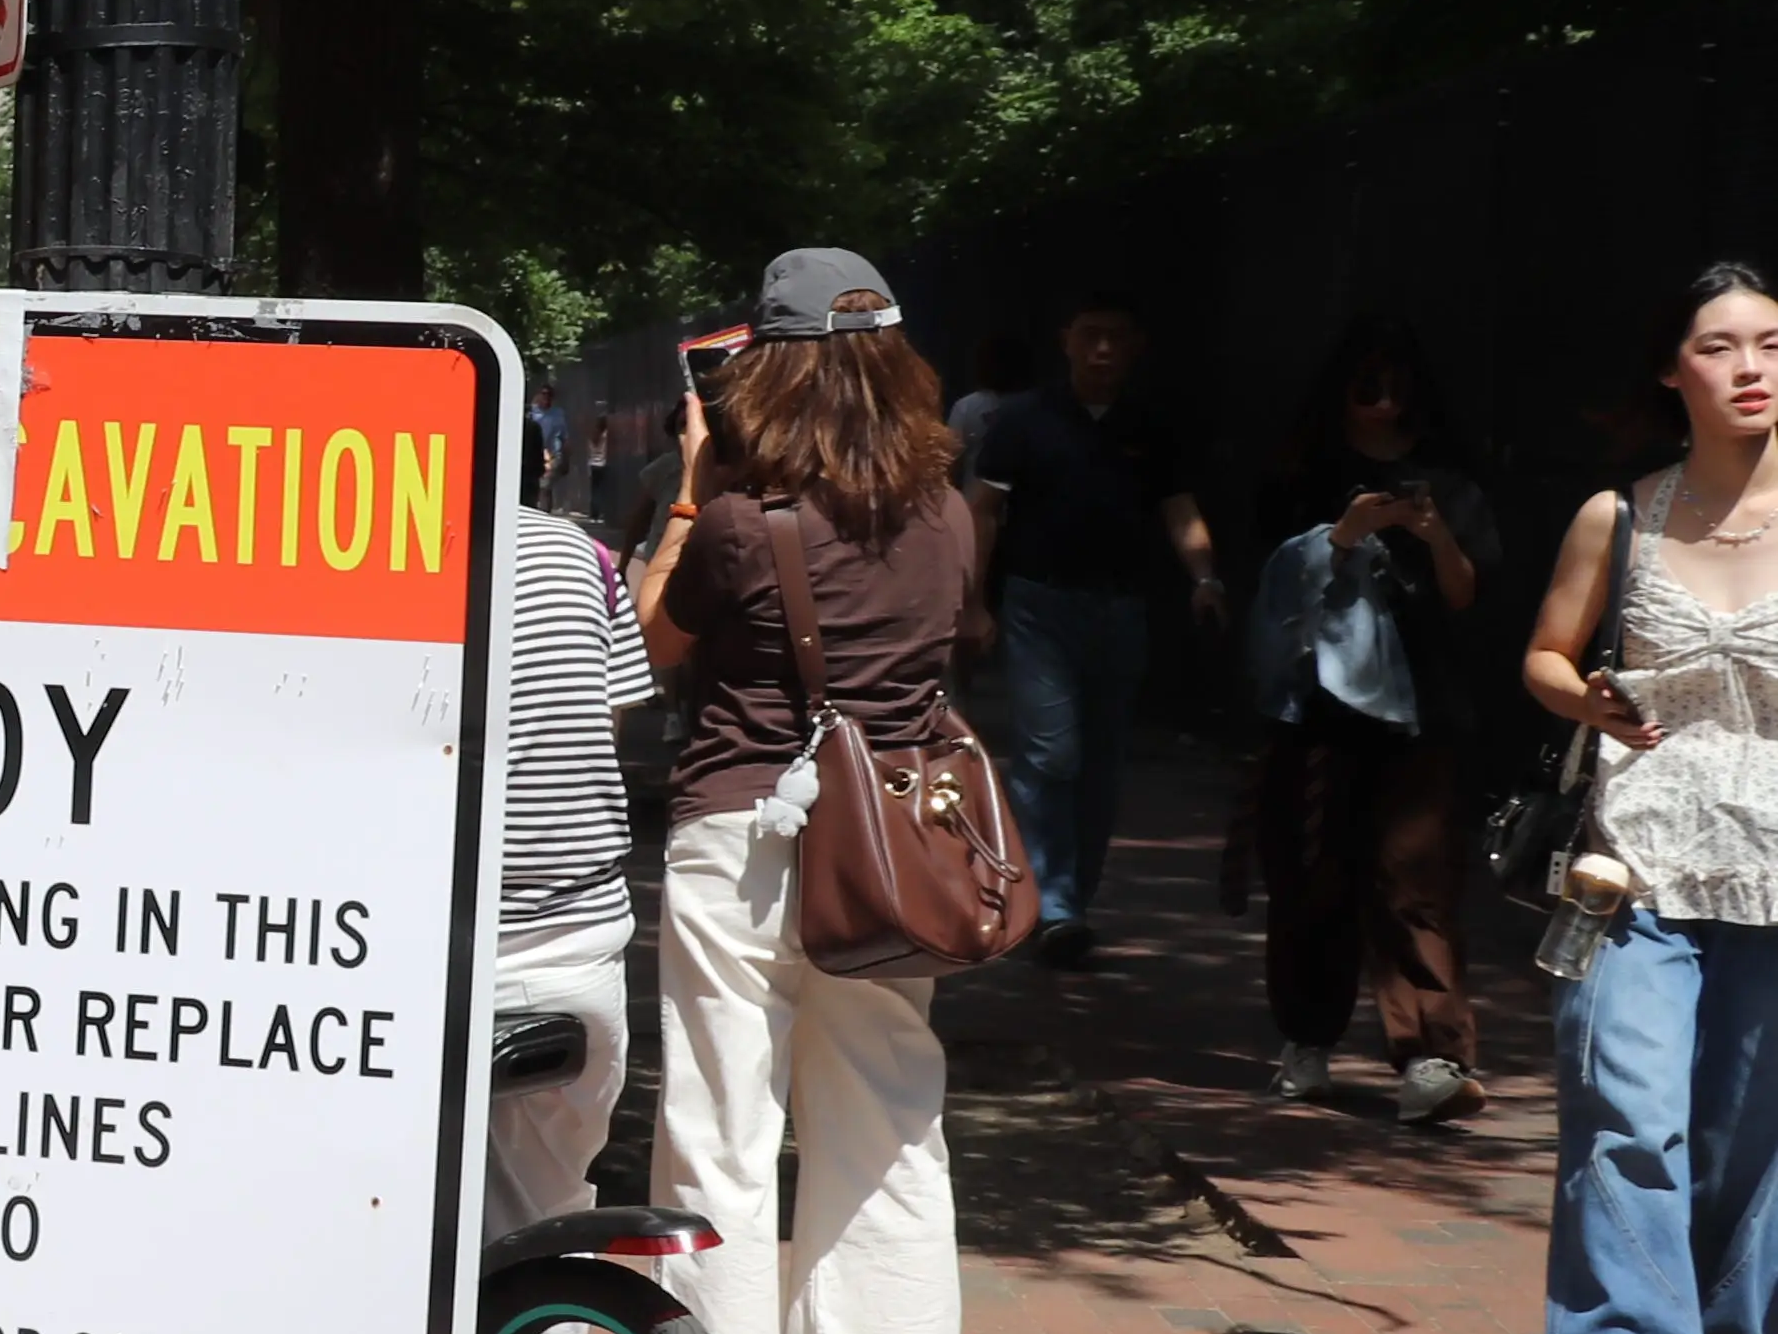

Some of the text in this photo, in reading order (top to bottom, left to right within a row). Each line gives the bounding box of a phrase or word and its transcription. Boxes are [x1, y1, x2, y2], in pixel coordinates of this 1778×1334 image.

[116, 887, 181, 956] IN
[216, 893, 370, 969] THIS
[76, 990, 394, 1079] REPLACE
